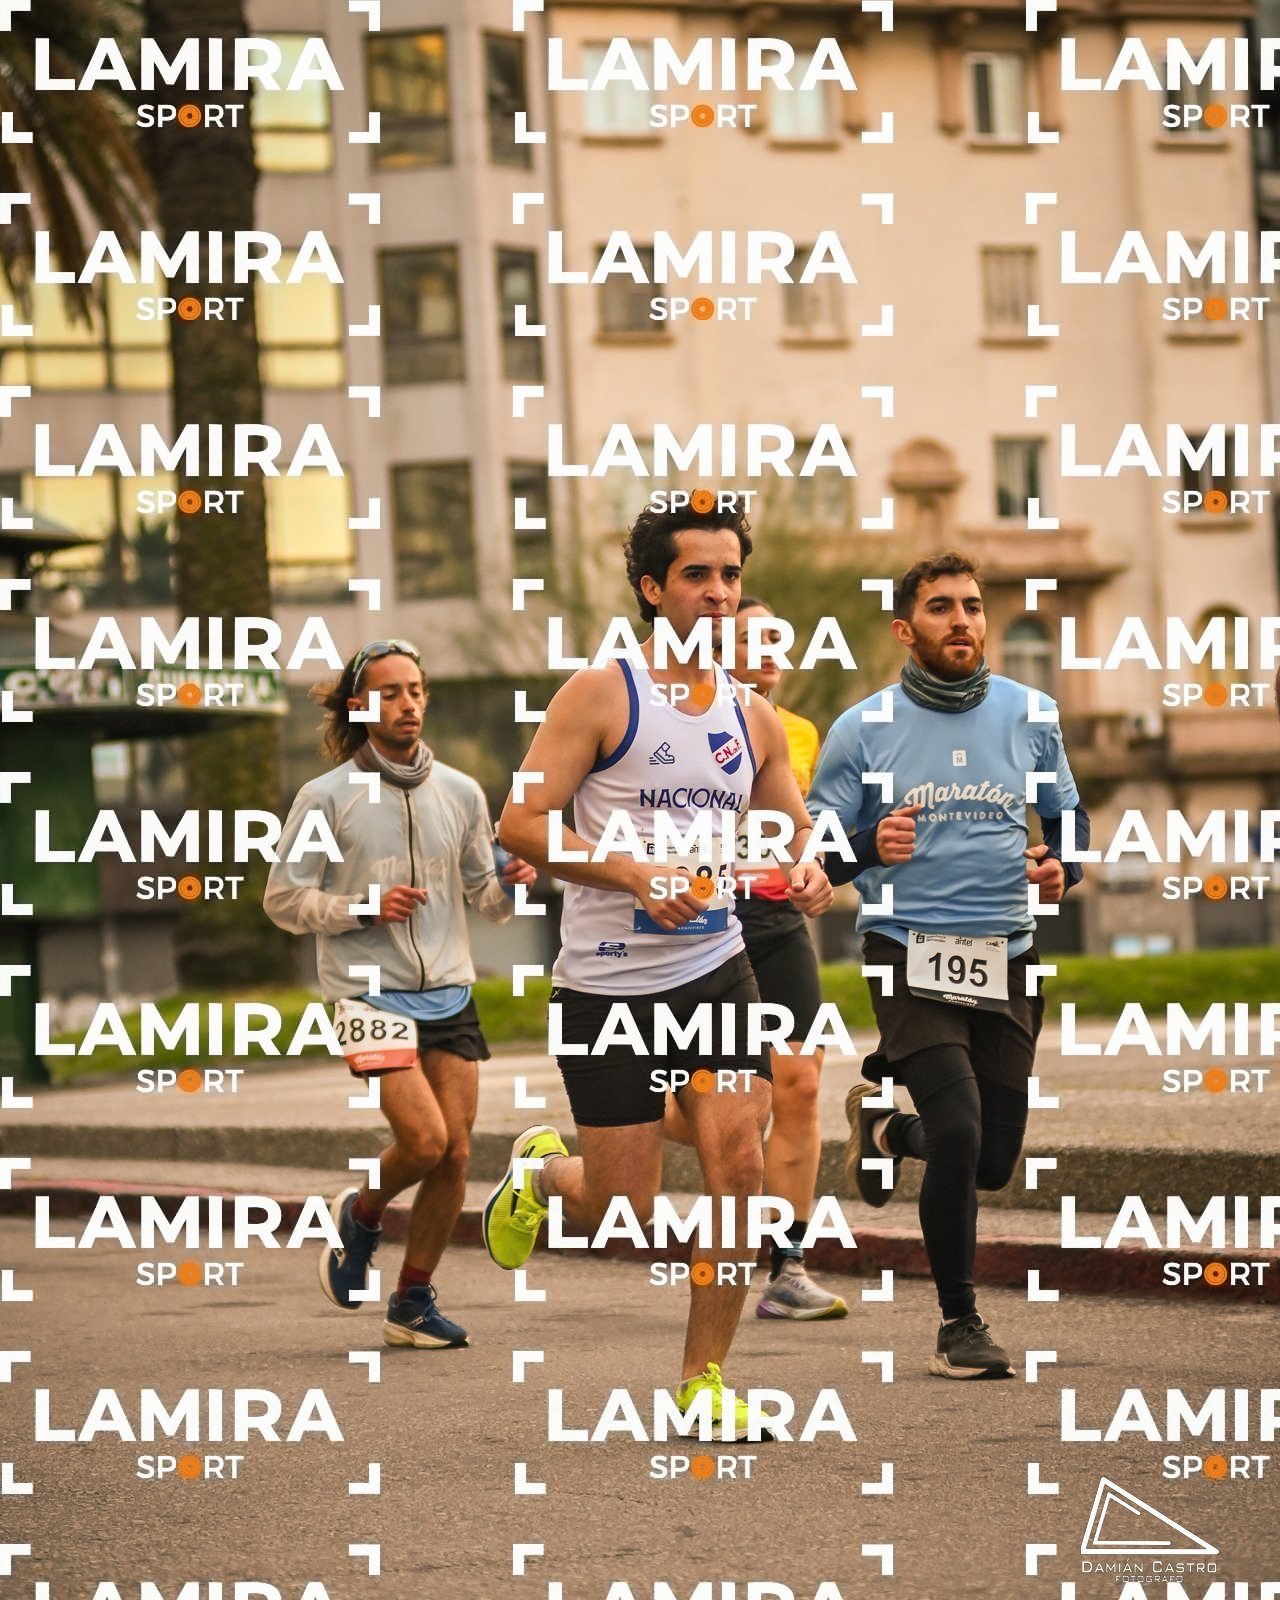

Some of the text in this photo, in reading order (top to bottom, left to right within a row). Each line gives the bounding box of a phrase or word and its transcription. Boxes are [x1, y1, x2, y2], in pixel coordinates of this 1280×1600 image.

[640, 788, 743, 814] NACIONAL
[904, 781, 1016, 810] Maratón
[918, 811, 1004, 823] MONTEVIDEO
[596, 950, 628, 958] sporty's
[928, 952, 988, 988] 195
[336, 1018, 408, 1046] 2882
